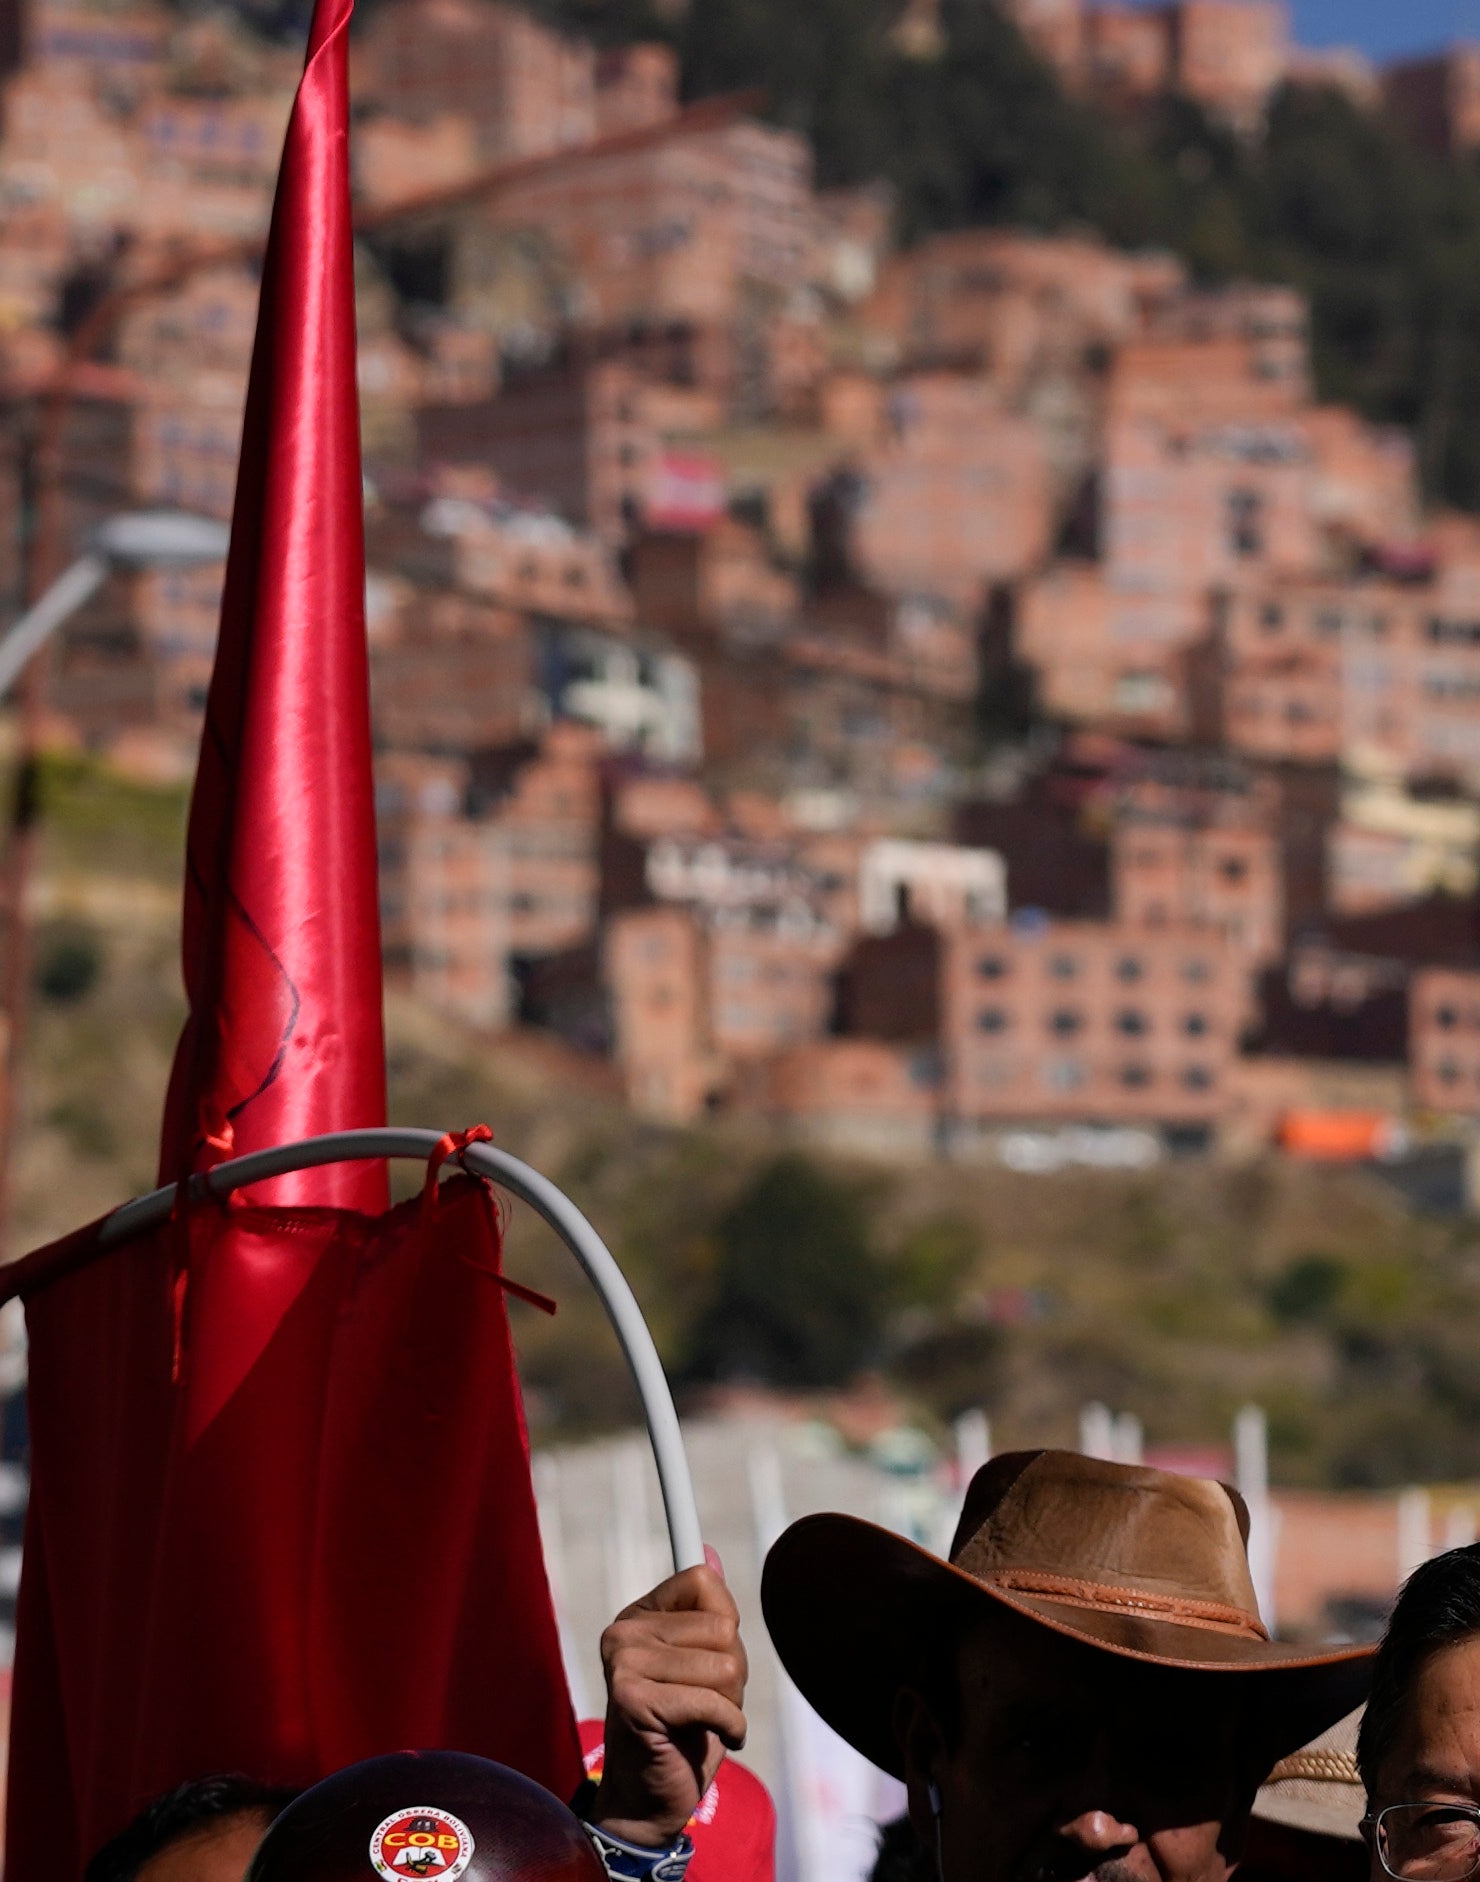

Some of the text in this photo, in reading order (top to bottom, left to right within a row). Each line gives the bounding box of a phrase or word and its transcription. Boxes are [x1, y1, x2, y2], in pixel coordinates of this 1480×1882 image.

[372, 1809, 469, 1858] CENTRAL OBRERA BOLIVIANA
[383, 1832, 459, 1850] COB
